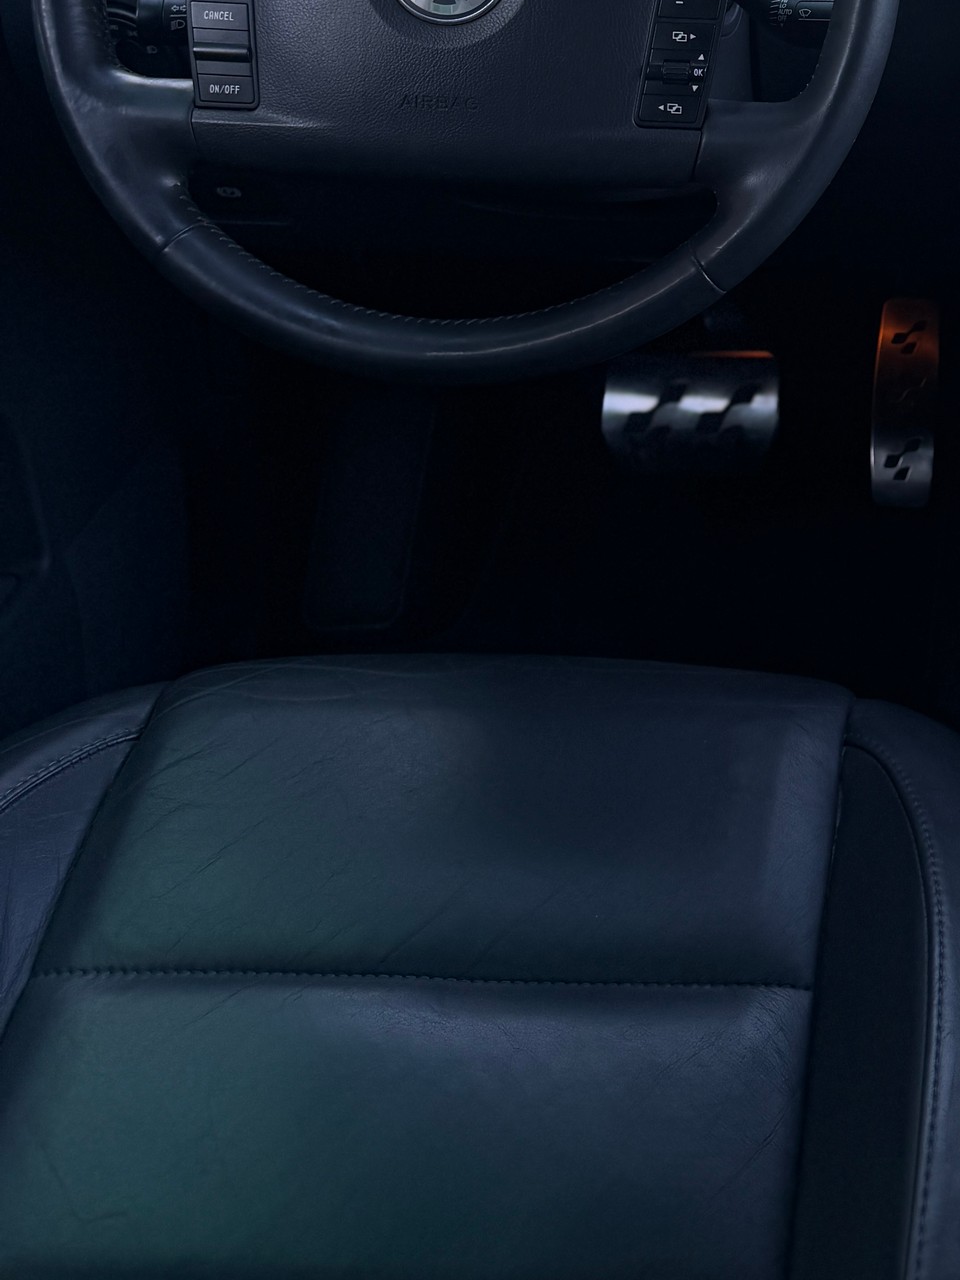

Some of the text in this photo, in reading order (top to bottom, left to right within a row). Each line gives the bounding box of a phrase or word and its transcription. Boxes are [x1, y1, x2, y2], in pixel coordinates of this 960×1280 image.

[203, 10, 235, 22] CANCEL
[693, 67, 704, 78] OK
[209, 84, 241, 95] ON/OFF
[400, 94, 478, 111] AIRBAG
